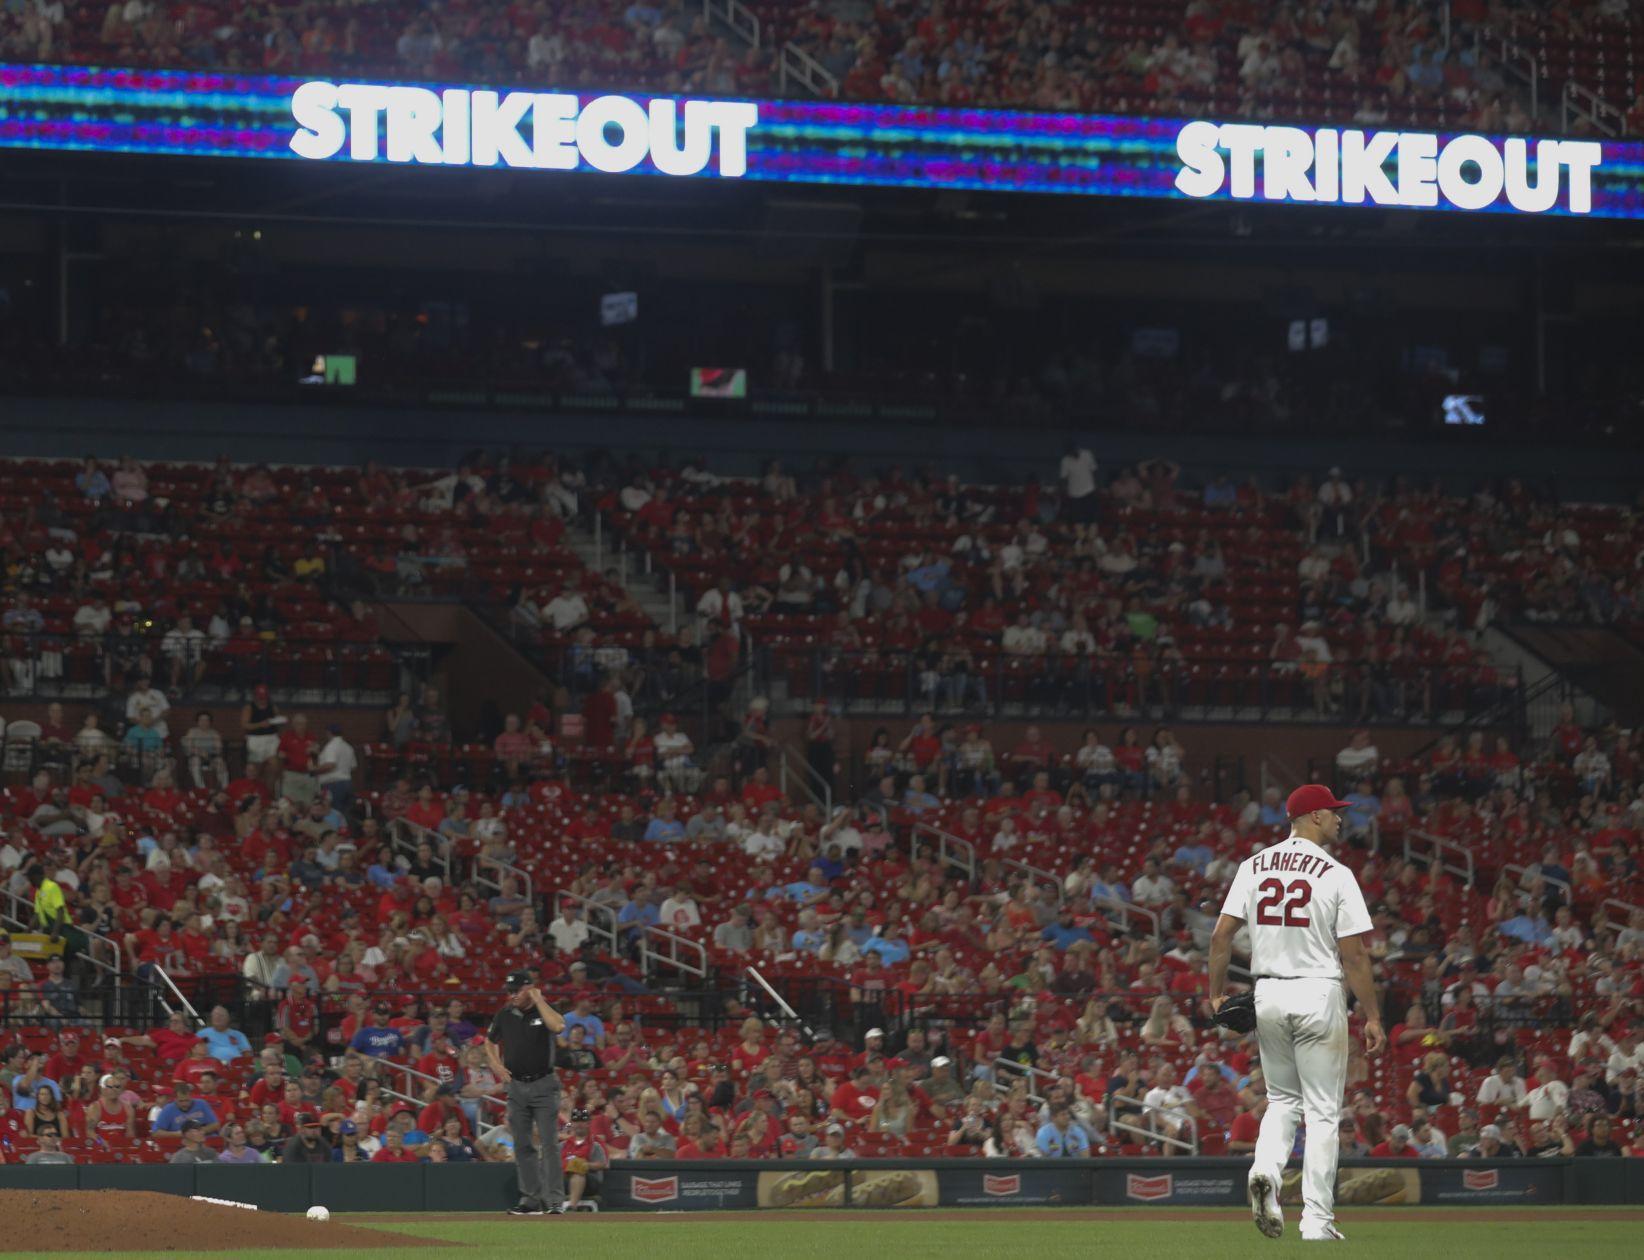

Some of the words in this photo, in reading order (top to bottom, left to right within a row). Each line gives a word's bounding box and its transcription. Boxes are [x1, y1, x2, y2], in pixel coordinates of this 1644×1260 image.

[289, 82, 757, 176] STRIKEOUT
[1175, 122, 1601, 212] STRIKEOUT
[1253, 852, 1334, 879] FLAHERTY
[1257, 878, 1312, 928] 22
